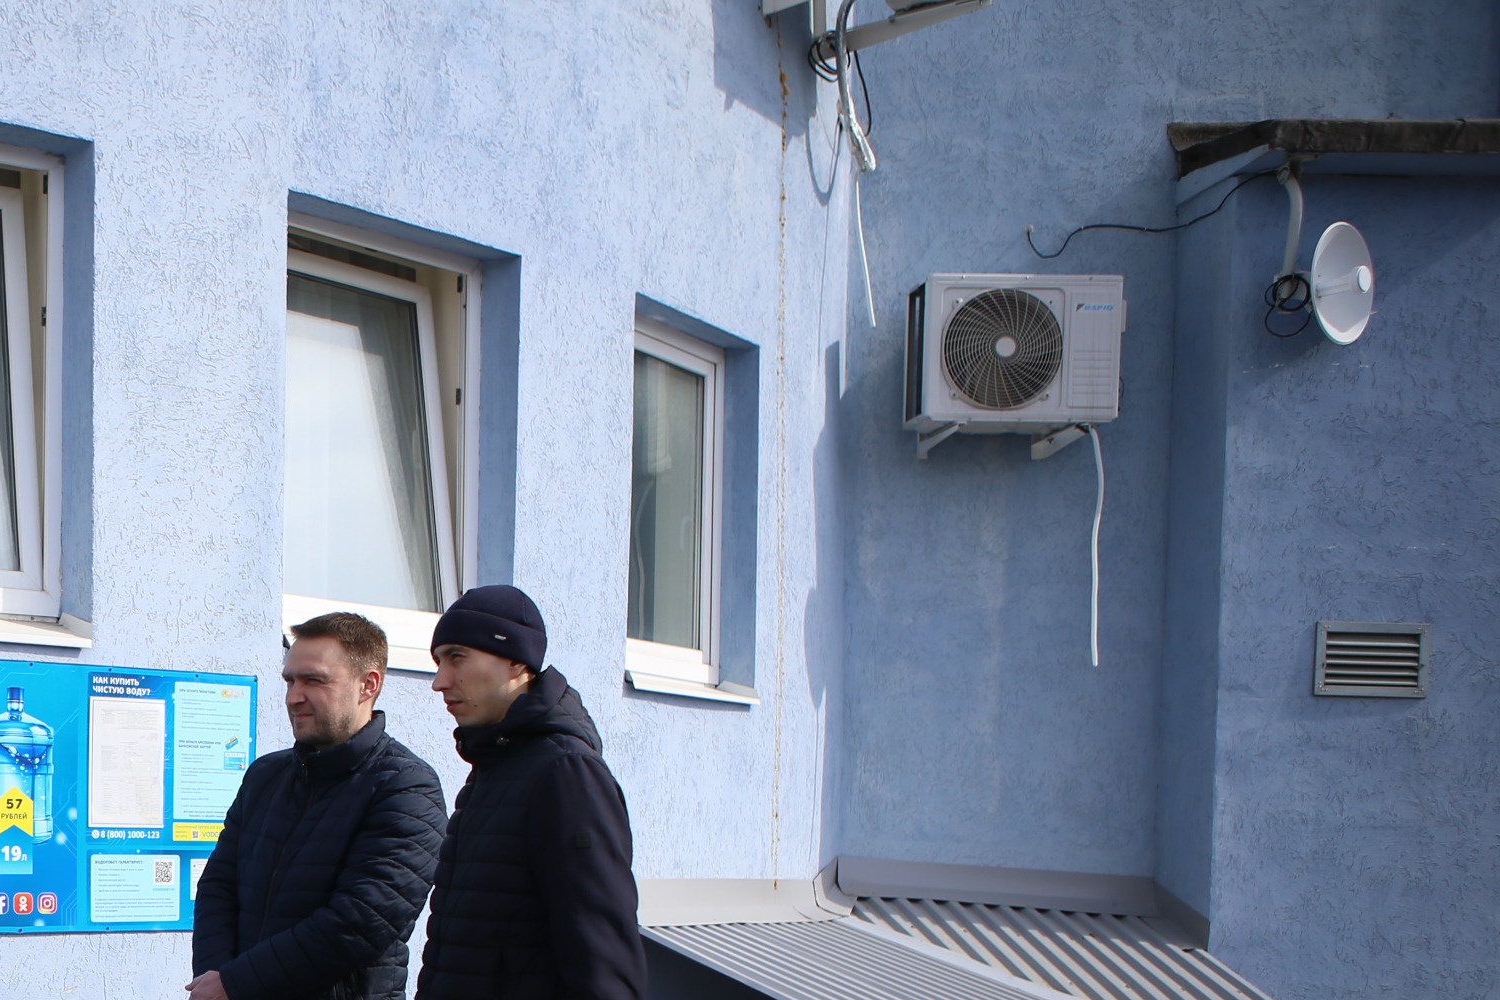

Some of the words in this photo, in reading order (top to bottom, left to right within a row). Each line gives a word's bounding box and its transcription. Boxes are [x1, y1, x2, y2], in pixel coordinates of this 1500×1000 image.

[93, 676, 108, 684] КАК
[110, 677, 139, 686] КУПИТЬ
[92, 685, 125, 695] ЧИСТУЮ
[126, 687, 151, 696] ВОДУ?
[6, 798, 23, 810] 57
[0, 812, 28, 820] РУБЛЕЙ
[100, 831, 106, 839] 8
[107, 830, 126, 840] (800)
[127, 831, 160, 839] 1000-123
[1, 845, 28, 862] 19л
